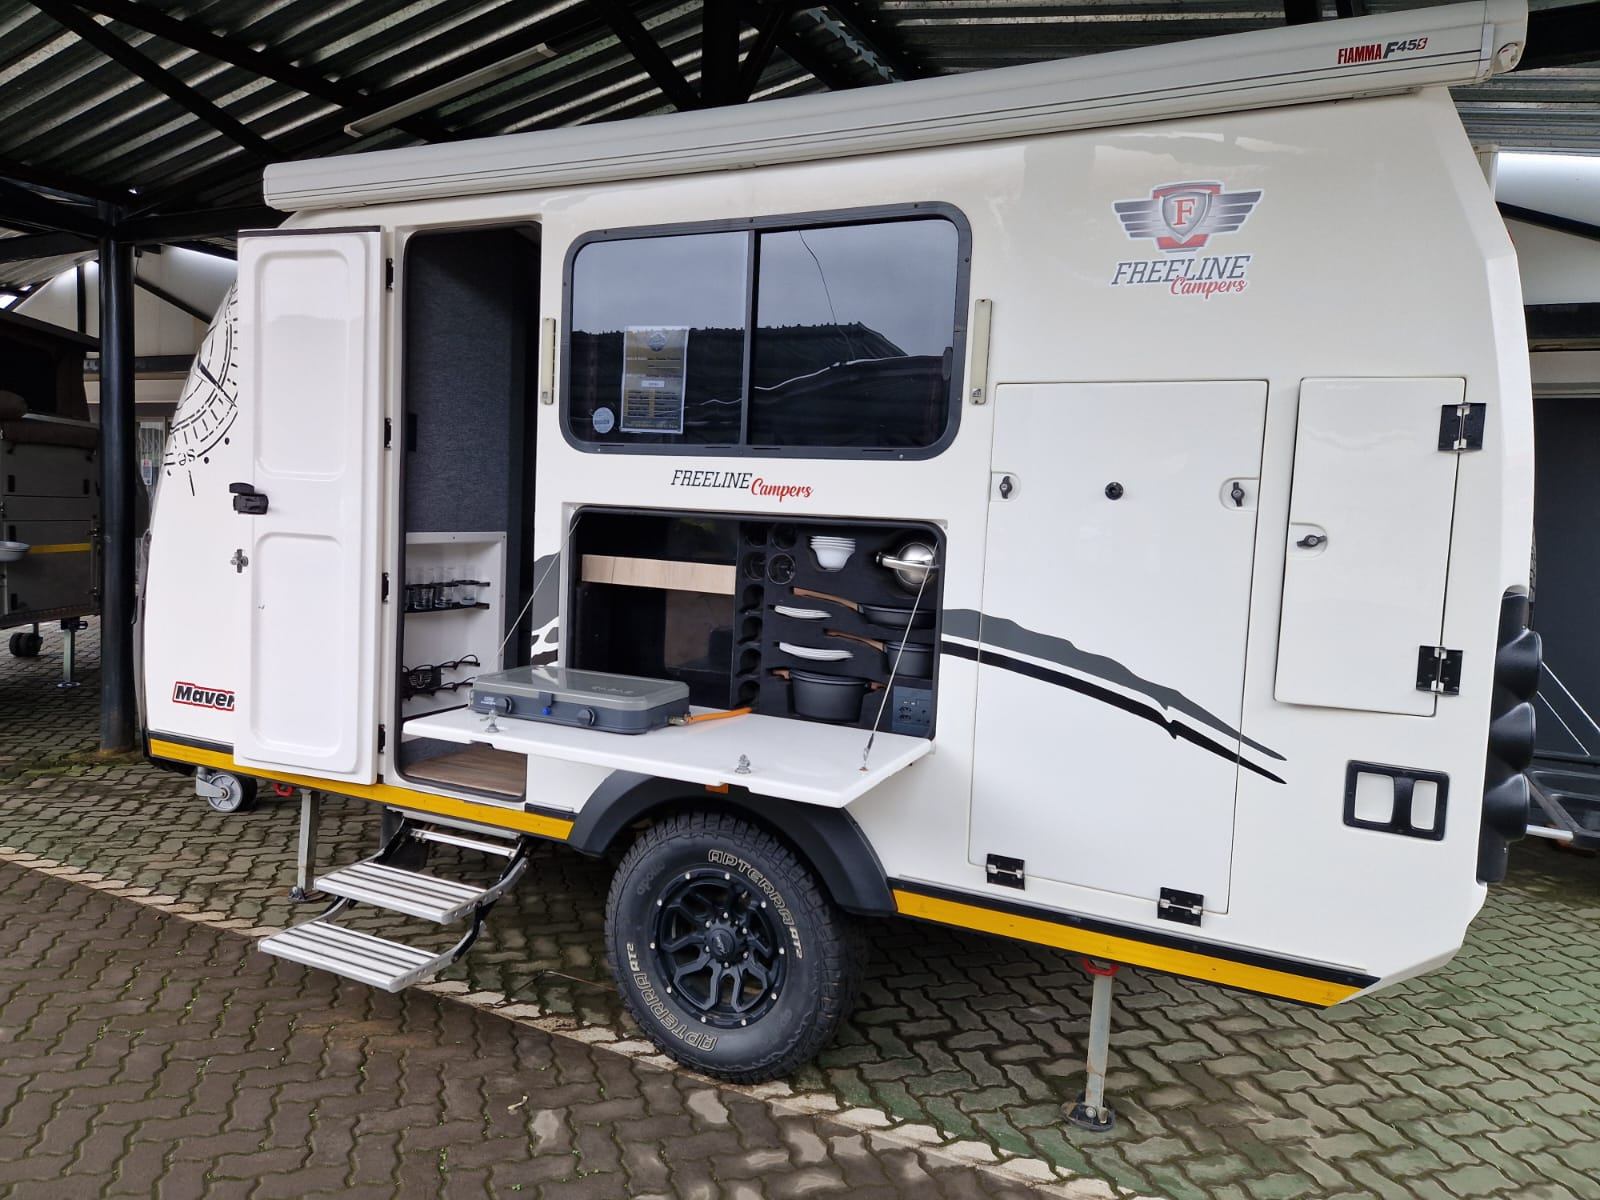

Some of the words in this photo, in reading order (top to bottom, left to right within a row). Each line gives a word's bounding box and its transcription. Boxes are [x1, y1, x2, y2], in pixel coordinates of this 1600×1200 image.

[1338, 43, 1382, 64] FIAMMA
[1172, 198, 1196, 226] F
[1111, 255, 1251, 285] FREELINE
[1170, 276, 1247, 299] Campers
[670, 469, 753, 490] FREELINE
[751, 477, 813, 502] Campers
[708, 849, 796, 927] APTERRA
[634, 972, 719, 1052] APTERRA
